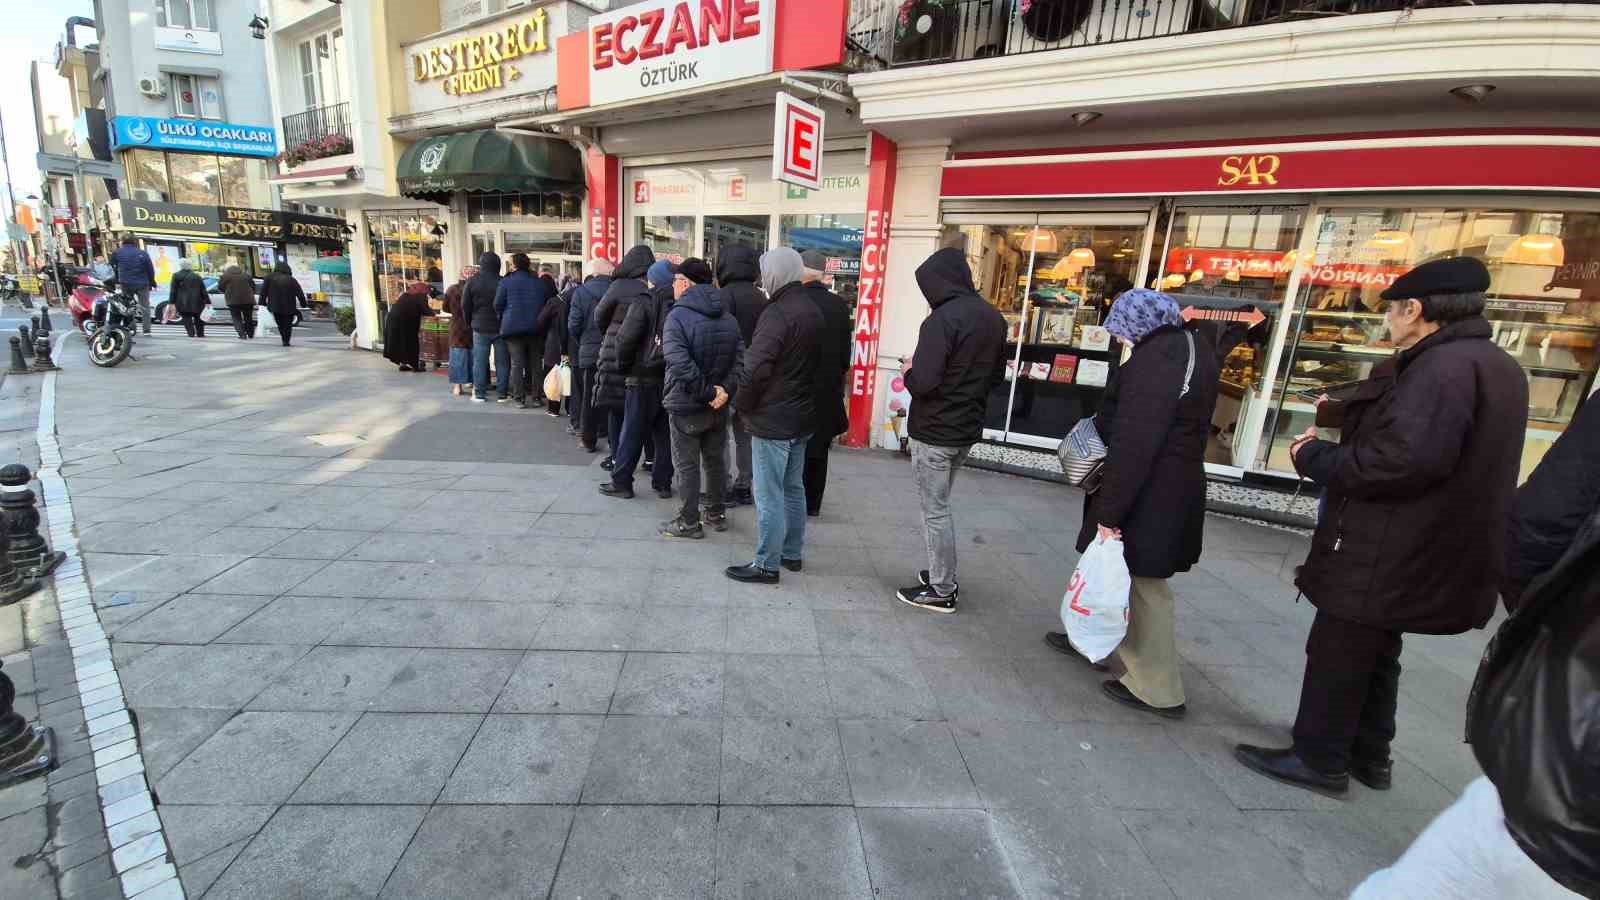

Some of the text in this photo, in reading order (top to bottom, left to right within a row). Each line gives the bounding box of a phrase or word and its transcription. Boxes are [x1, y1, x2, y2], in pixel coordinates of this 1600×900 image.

[413, 7, 549, 82] DESTERECİ
[592, 0, 761, 70] ECZANE
[640, 61, 698, 88] ÖZTÜRK
[157, 119, 273, 143] ÜLKÜ OCAKLARI
[792, 119, 814, 170] E
[821, 176, 861, 190] ПТЕКА
[1217, 154, 1281, 186] SAR
[853, 209, 880, 396] ECZANE
